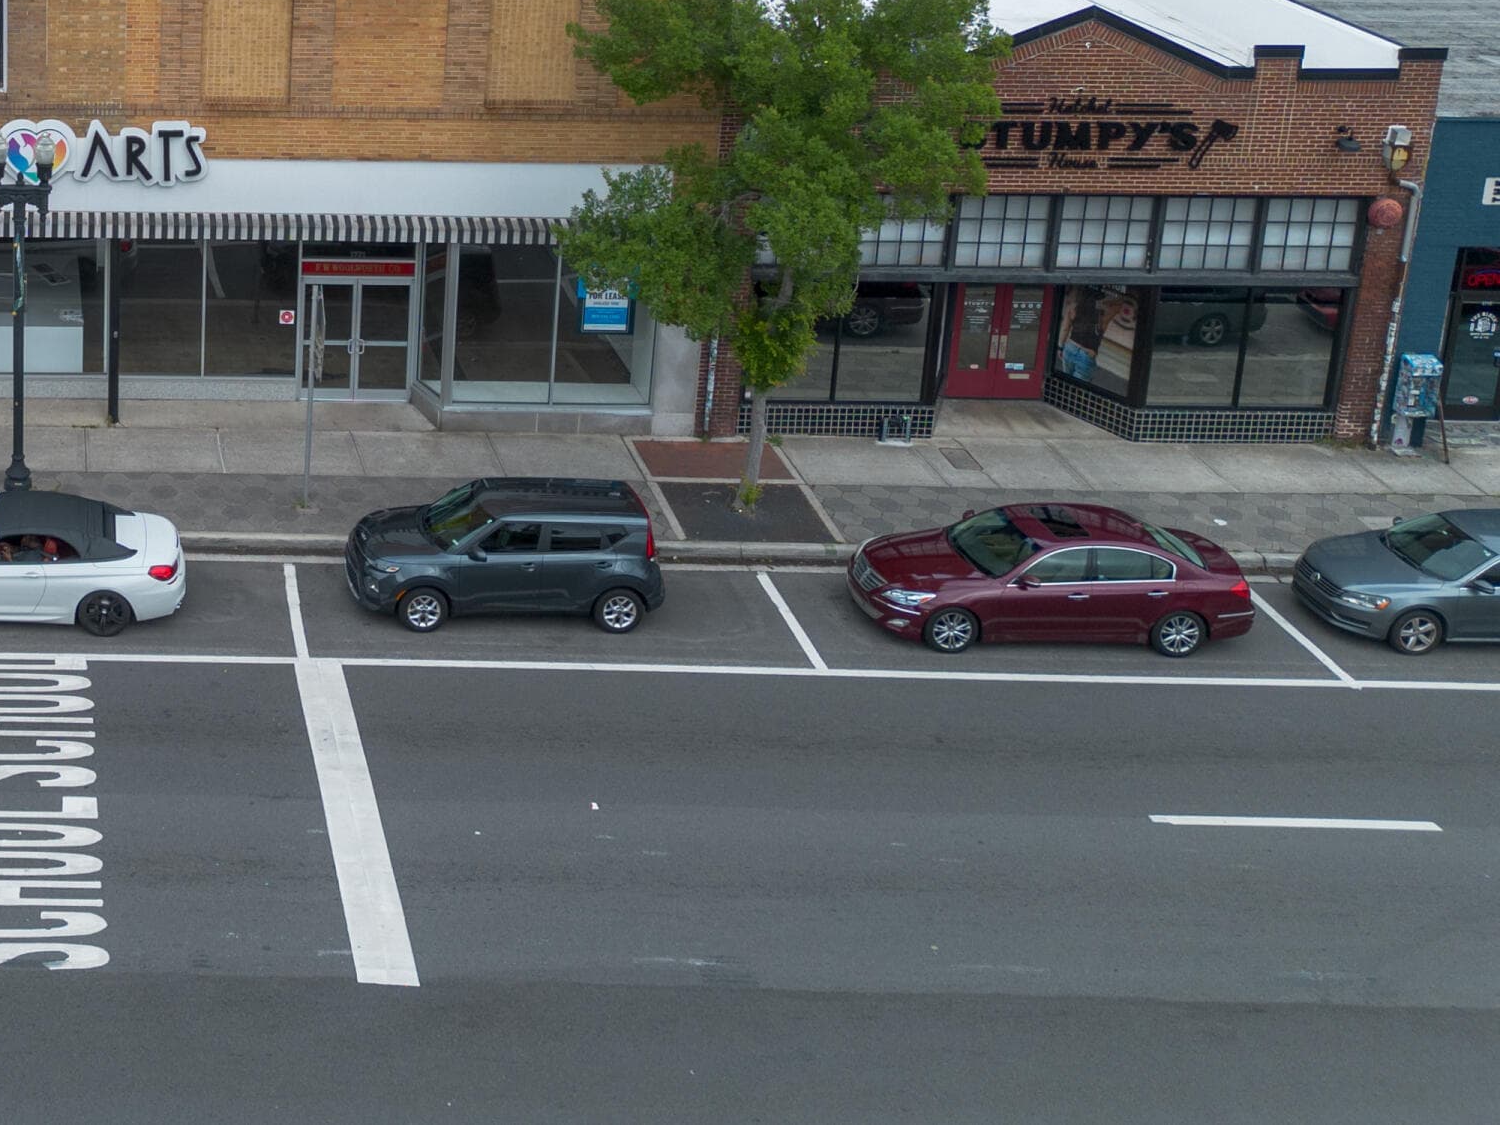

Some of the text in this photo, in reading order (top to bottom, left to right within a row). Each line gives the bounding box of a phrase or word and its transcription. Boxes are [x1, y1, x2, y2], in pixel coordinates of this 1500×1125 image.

[1049, 97, 1113, 115] Hatchet
[81, 129, 203, 182] ARTS
[1049, 151, 1098, 169] House
